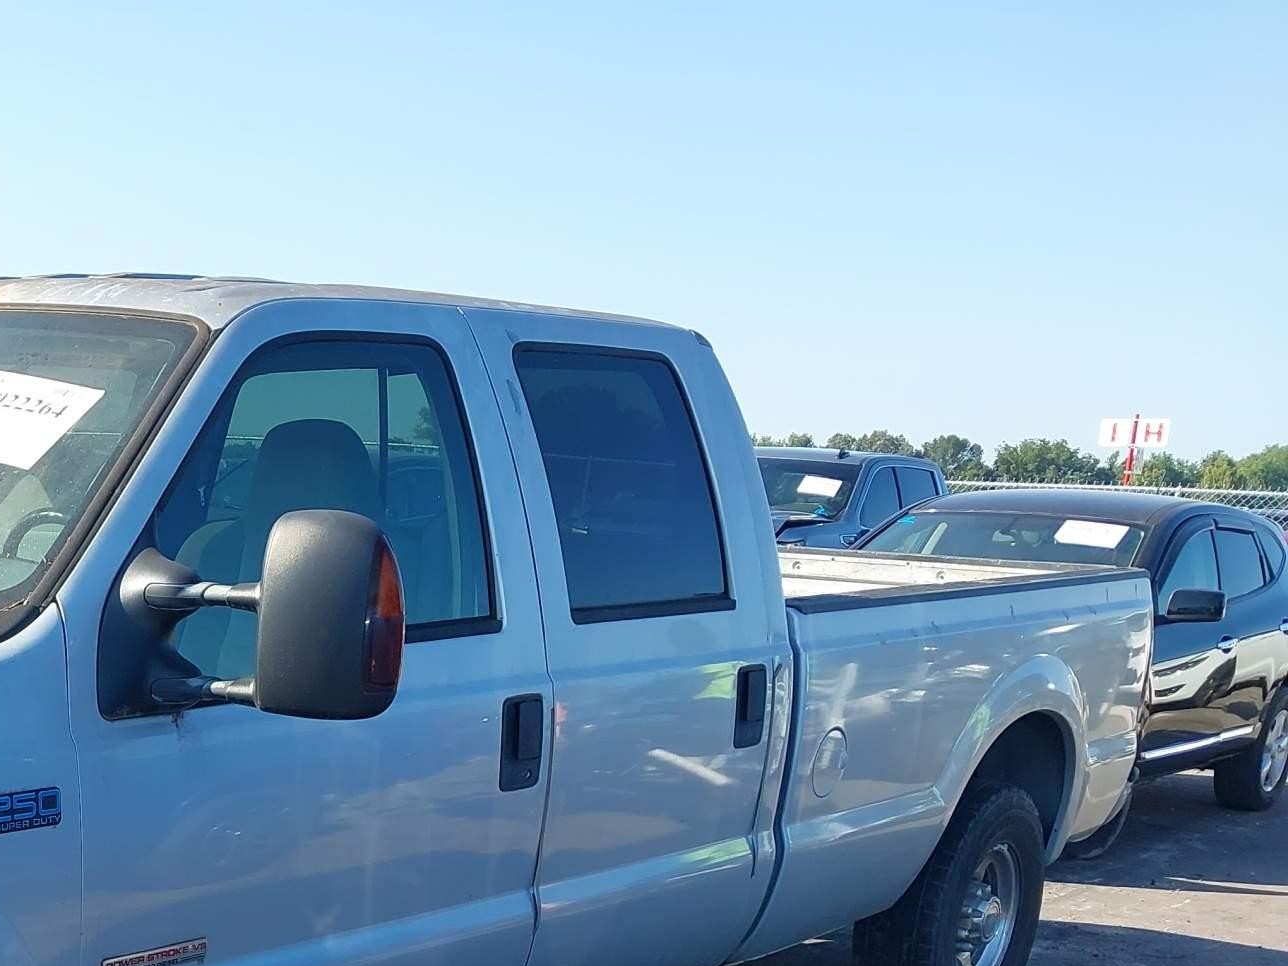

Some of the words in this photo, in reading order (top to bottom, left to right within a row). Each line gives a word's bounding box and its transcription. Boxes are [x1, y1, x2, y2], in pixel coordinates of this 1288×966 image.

[1143, 422, 1164, 443] H
[33, 815, 61, 826] DUTY
[147, 946, 189, 961] STROKE
